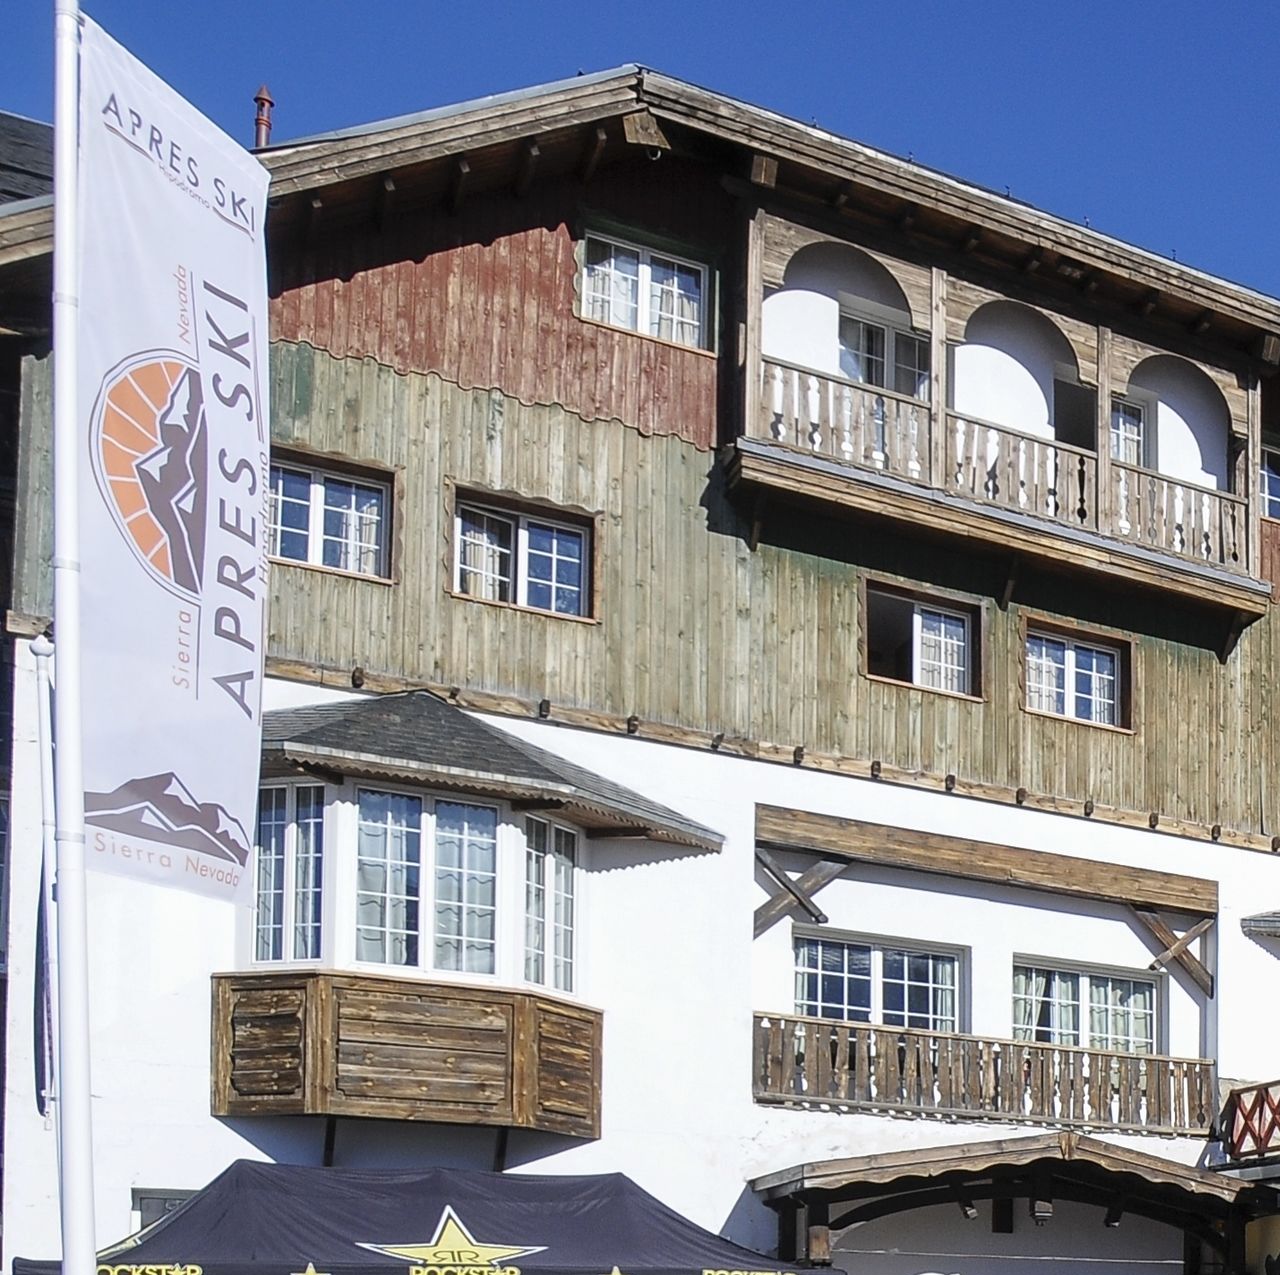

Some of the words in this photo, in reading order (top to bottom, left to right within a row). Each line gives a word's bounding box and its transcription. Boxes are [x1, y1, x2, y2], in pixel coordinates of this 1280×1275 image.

[102, 93, 199, 187] APRES
[213, 177, 255, 232] SKI
[172, 265, 190, 344] Nevada
[203, 280, 254, 421] SKI
[212, 448, 257, 720] APRES
[172, 610, 191, 689] Sierra
[94, 833, 172, 867] Sierra
[185, 855, 239, 887] Nevada
